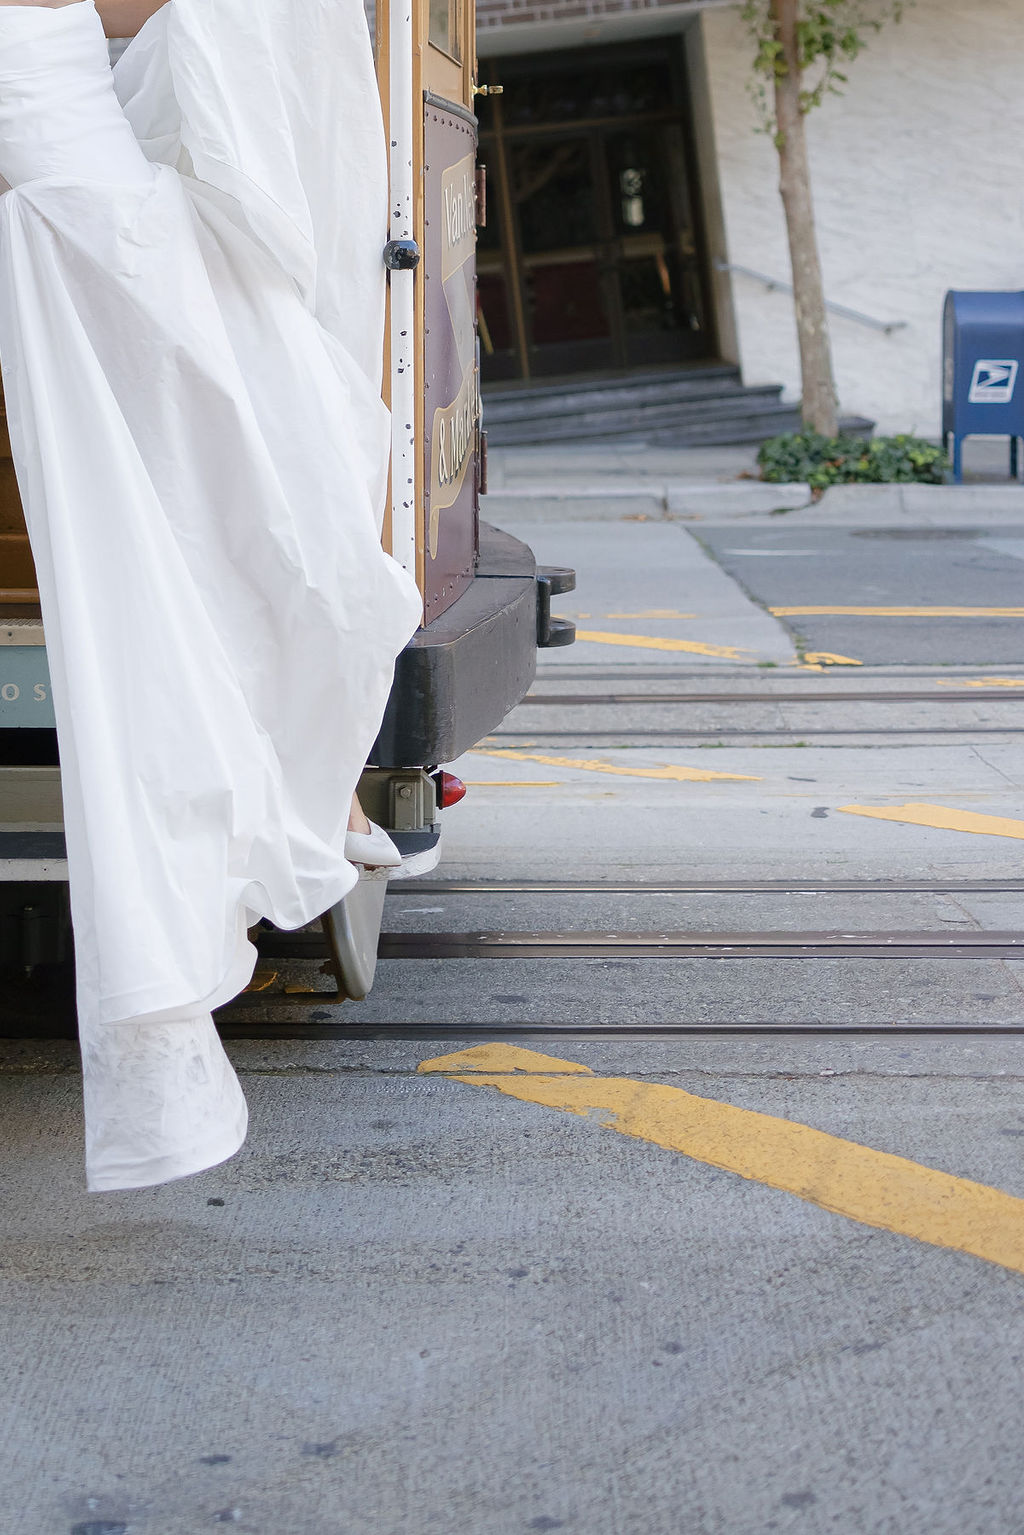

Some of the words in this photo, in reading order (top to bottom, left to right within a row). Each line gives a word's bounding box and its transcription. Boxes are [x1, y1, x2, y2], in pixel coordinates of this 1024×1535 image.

[444, 183, 464, 249] Van
[439, 417, 449, 485] &
[33, 683, 48, 702] S
